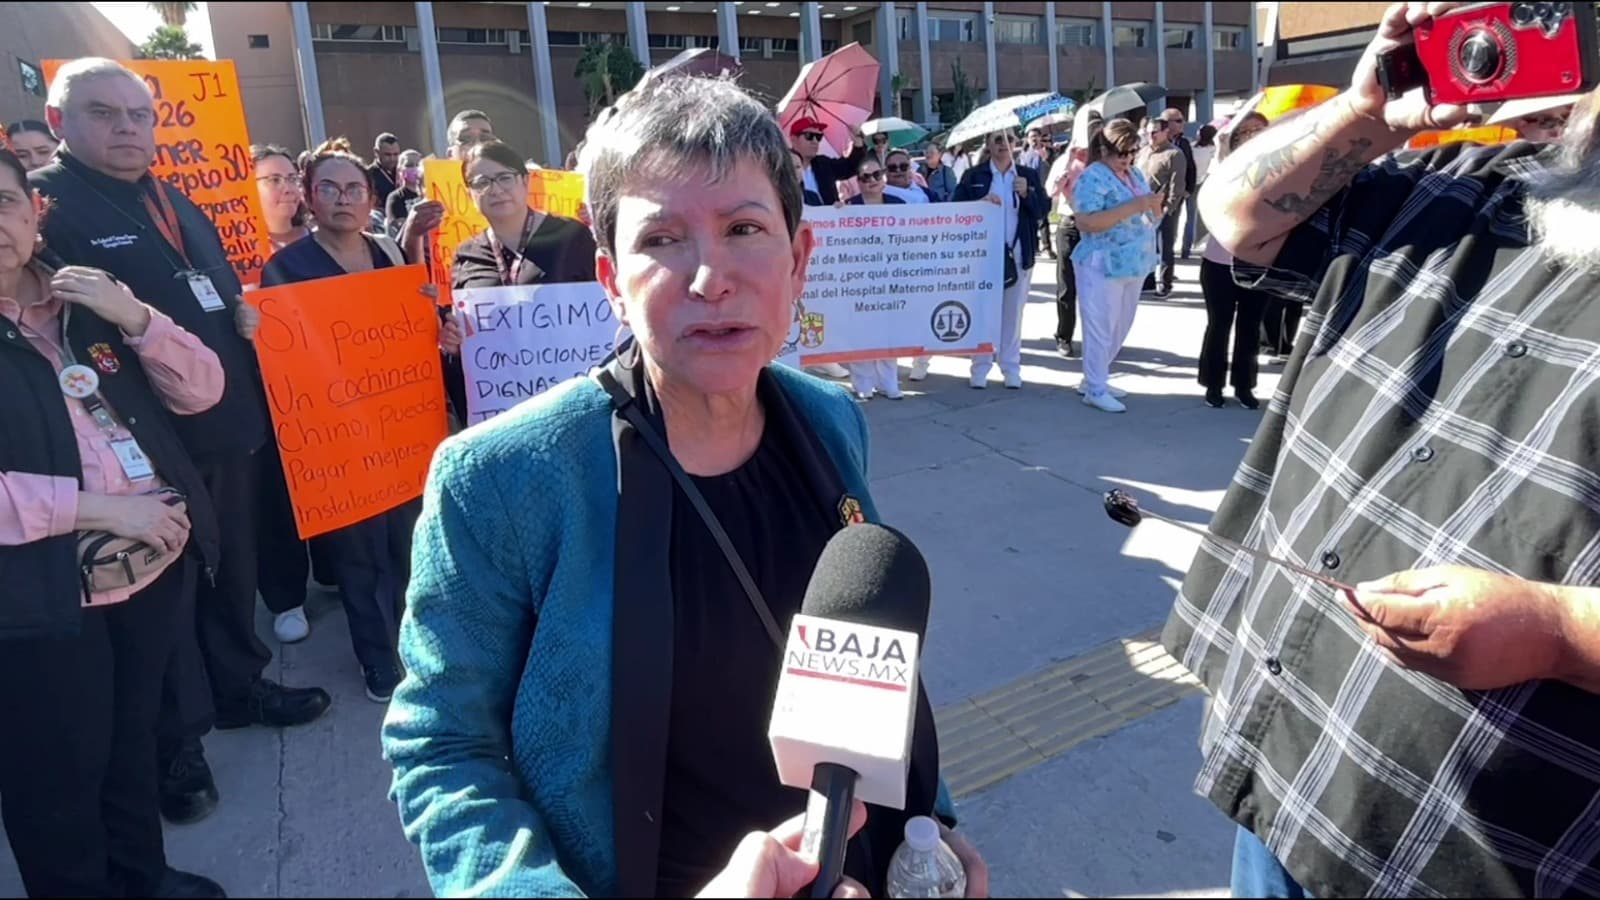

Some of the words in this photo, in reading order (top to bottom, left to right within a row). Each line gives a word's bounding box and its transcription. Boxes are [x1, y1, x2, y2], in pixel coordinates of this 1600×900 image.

[188, 72, 227, 102] J1
[166, 167, 222, 196] epto
[839, 215, 896, 228] RESPETO
[899, 217, 906, 226] a
[908, 214, 953, 226] nuestro
[955, 213, 984, 226] logro
[226, 238, 258, 255] alir
[826, 233, 885, 246] Ensenada,
[888, 232, 929, 246] Tijuana
[931, 233, 938, 245] y
[941, 229, 988, 243] Hospital
[822, 253, 836, 265] de
[838, 250, 883, 264] Mexicali
[886, 252, 900, 263] ya
[902, 250, 938, 261] tienen
[940, 249, 955, 260] su
[957, 247, 988, 258] sexta
[840, 270, 866, 283] ¿por
[867, 266, 890, 281] qué
[892, 265, 959, 279] discriminan
[960, 263, 971, 275] al
[821, 287, 839, 299] del
[841, 283, 886, 298] Hospital
[889, 282, 935, 295] Materno
[937, 279, 975, 293] Infantil
[977, 279, 994, 291] de
[854, 299, 907, 313] Mexicali?
[258, 297, 309, 353] Si
[268, 375, 315, 416] Un
[277, 418, 370, 453] Chino,
[814, 628, 907, 665] BAJA
[787, 650, 909, 683] NEWS.MX
